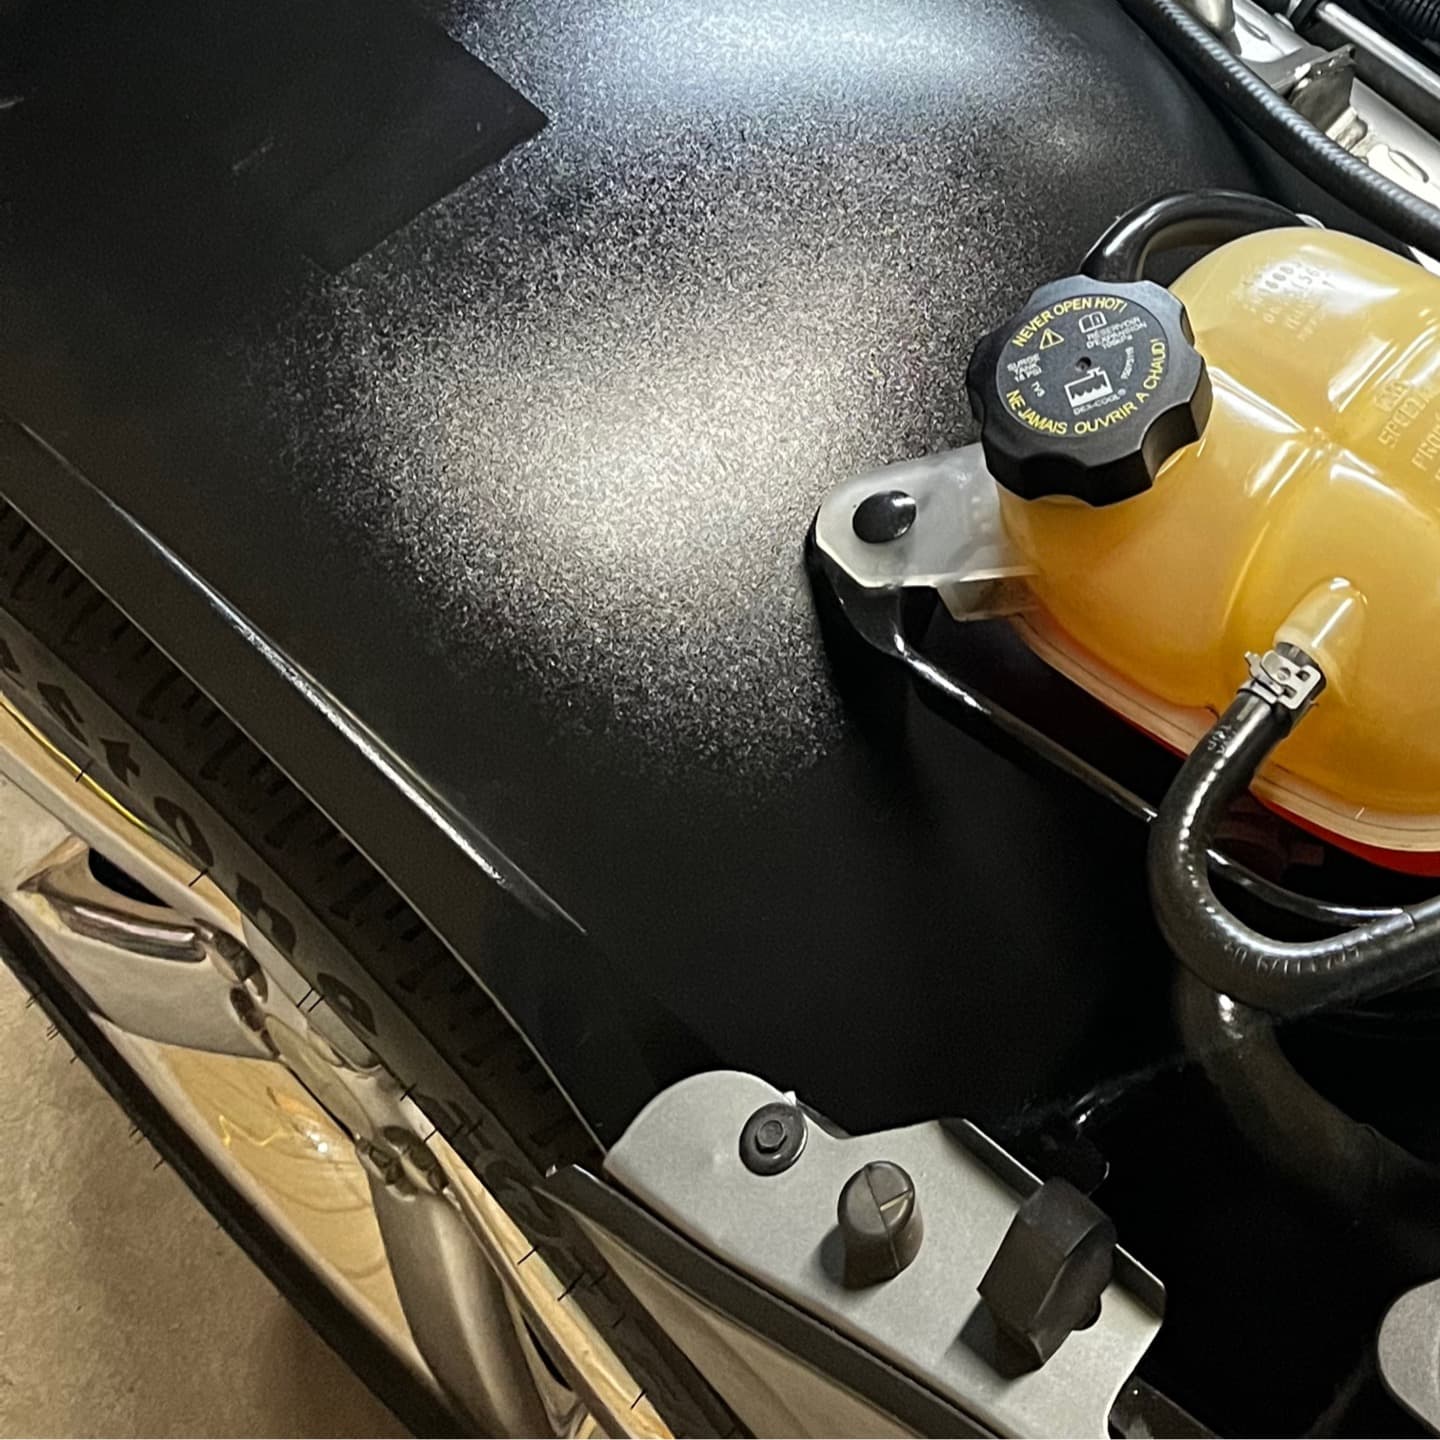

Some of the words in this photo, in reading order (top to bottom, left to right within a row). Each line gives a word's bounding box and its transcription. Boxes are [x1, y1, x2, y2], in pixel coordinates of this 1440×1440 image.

[1012, 310, 1055, 348] NEVER
[1053, 297, 1093, 317] OPEN
[1093, 296, 1129, 314] HOT!
[1006, 388, 1026, 410] NE
[1018, 403, 1068, 435] JAMAIS
[1074, 401, 1139, 435] OUVRIR
